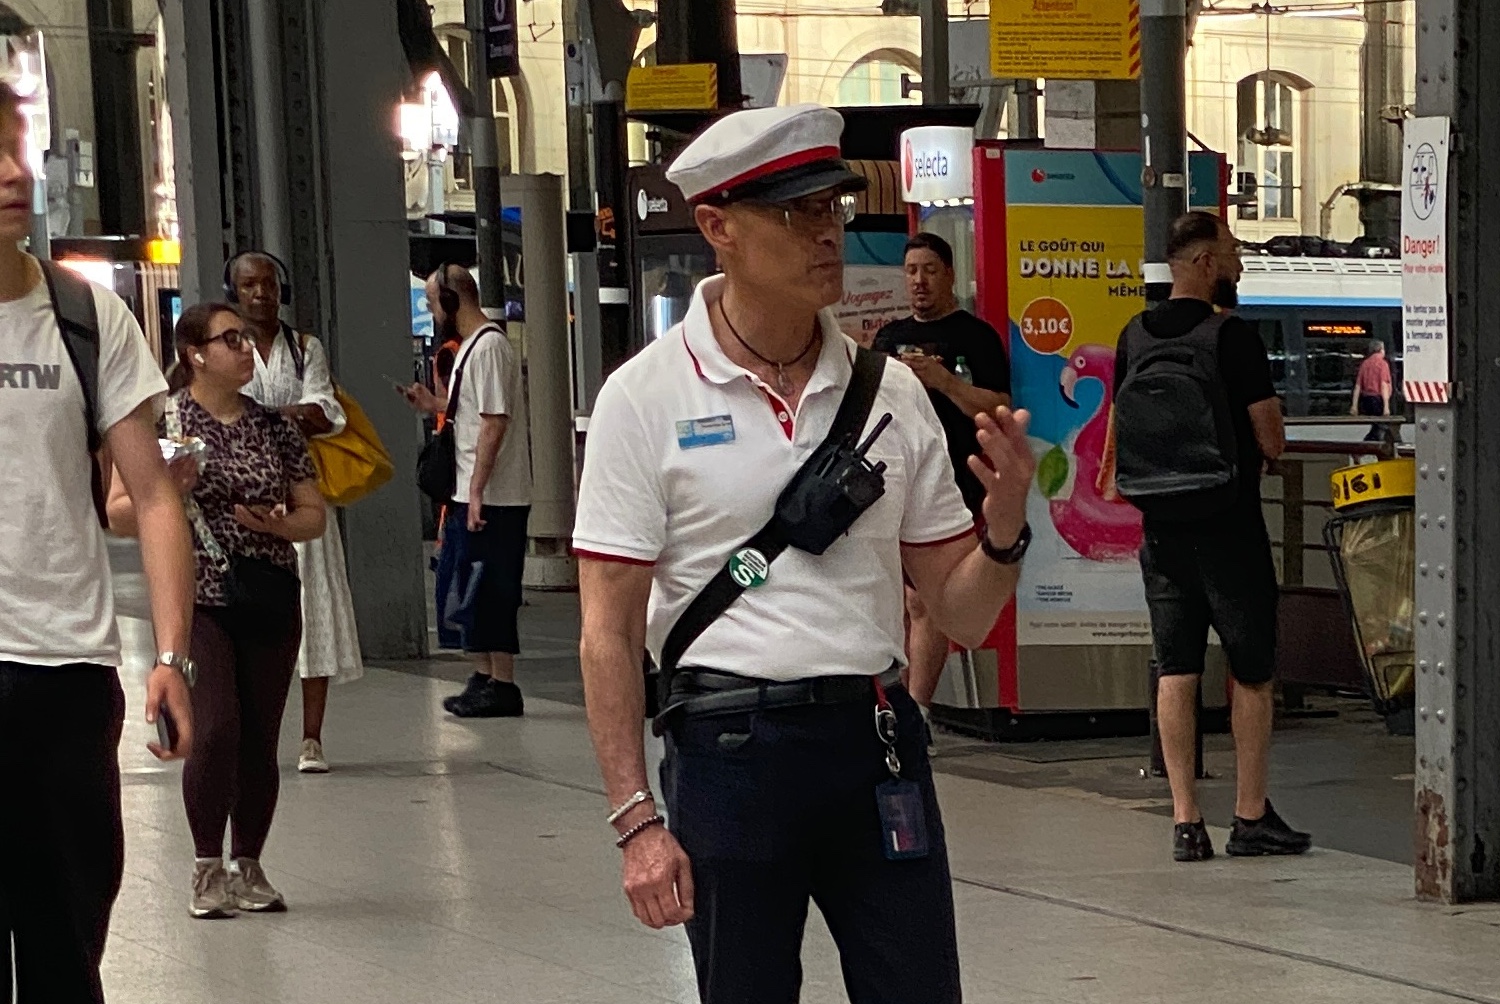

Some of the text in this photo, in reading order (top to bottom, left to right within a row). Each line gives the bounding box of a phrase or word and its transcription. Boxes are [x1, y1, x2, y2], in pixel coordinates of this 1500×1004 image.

[915, 151, 948, 179] selecta
[1020, 238, 1105, 252] LE GOÛT QUI
[1404, 235, 1440, 258] Danger!
[1020, 258, 1099, 279] DONNE
[1106, 259, 1131, 279] LA
[842, 289, 893, 307] Voyagez
[1109, 283, 1146, 296] MÊME
[1023, 317, 1071, 335] 3,10€
[0, 362, 60, 390] RTW
